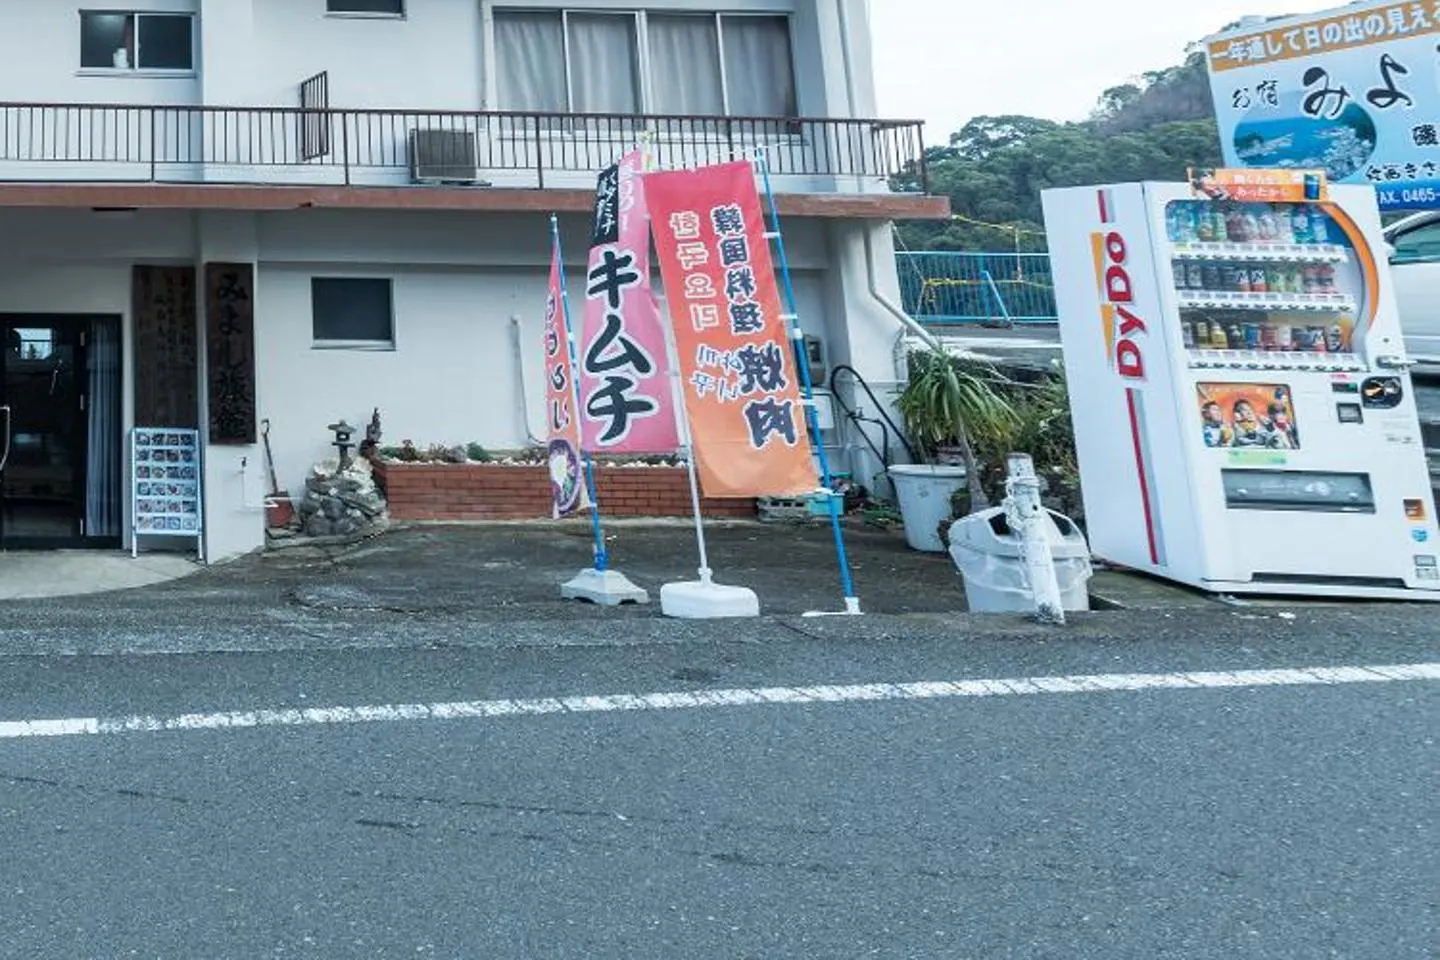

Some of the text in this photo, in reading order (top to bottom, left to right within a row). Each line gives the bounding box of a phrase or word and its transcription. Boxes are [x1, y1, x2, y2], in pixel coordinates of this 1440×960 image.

[1211, 1, 1440, 62] 一年通して日の出の見え
[1302, 44, 1440, 117] みよ
[585, 250, 655, 442] キムチ
